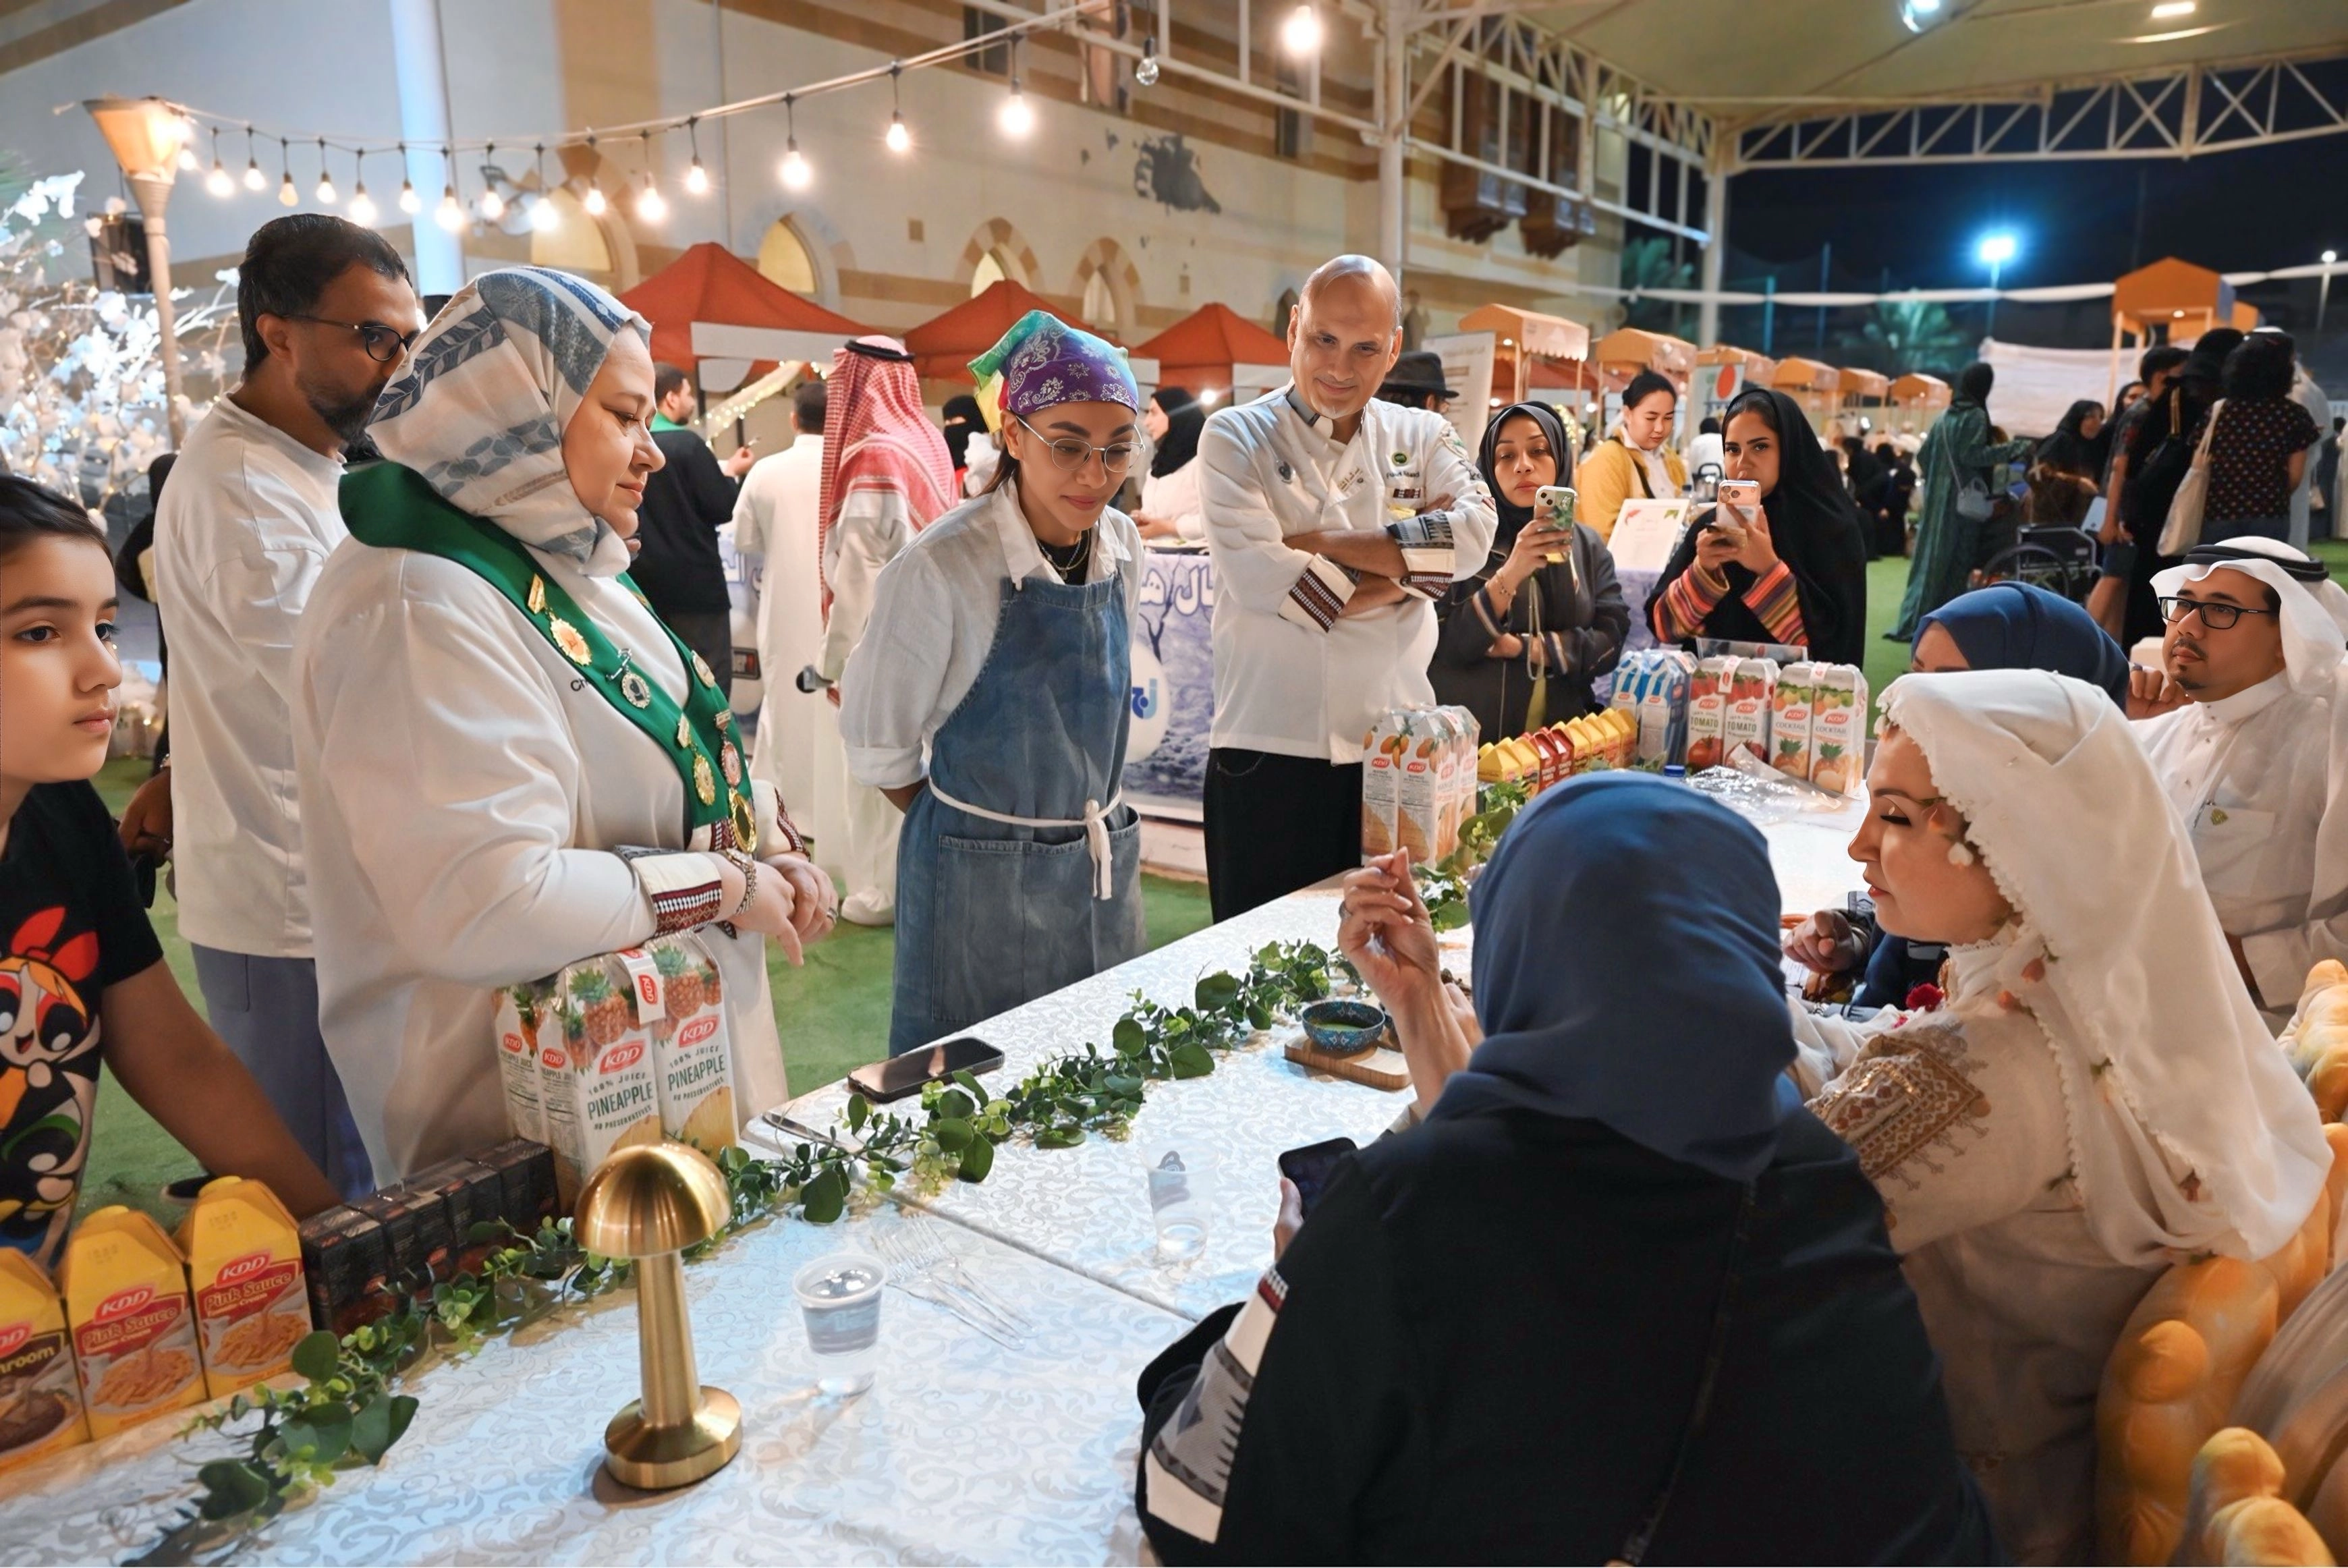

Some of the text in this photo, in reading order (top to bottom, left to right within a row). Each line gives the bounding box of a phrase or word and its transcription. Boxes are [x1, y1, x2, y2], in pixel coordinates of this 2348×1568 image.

[1690, 717, 1718, 728] TOMATO
[1728, 721, 1757, 733] TOMATO
[642, 977, 654, 1002] KDD
[505, 1037, 521, 1048] KDD
[683, 1021, 714, 1042] KDD
[543, 1053, 564, 1064] KDD
[605, 1046, 640, 1068] KDD
[669, 1045, 719, 1068] 100% JUICE
[588, 1080, 613, 1096] 100%
[619, 1072, 646, 1084] JUICE
[668, 1055, 725, 1091] PINEAPPLE
[683, 1076, 724, 1100] PRESERVATIVES
[587, 1082, 653, 1120] PINEAPPLE
[605, 1104, 652, 1129] PRESERVATIVES
[222, 1256, 266, 1281] KDD
[101, 1290, 149, 1316] KDD
[204, 1285, 242, 1312] Pink
[242, 1272, 291, 1297] Sauce
[82, 1322, 122, 1348] Pink
[123, 1307, 178, 1334] Sauce
